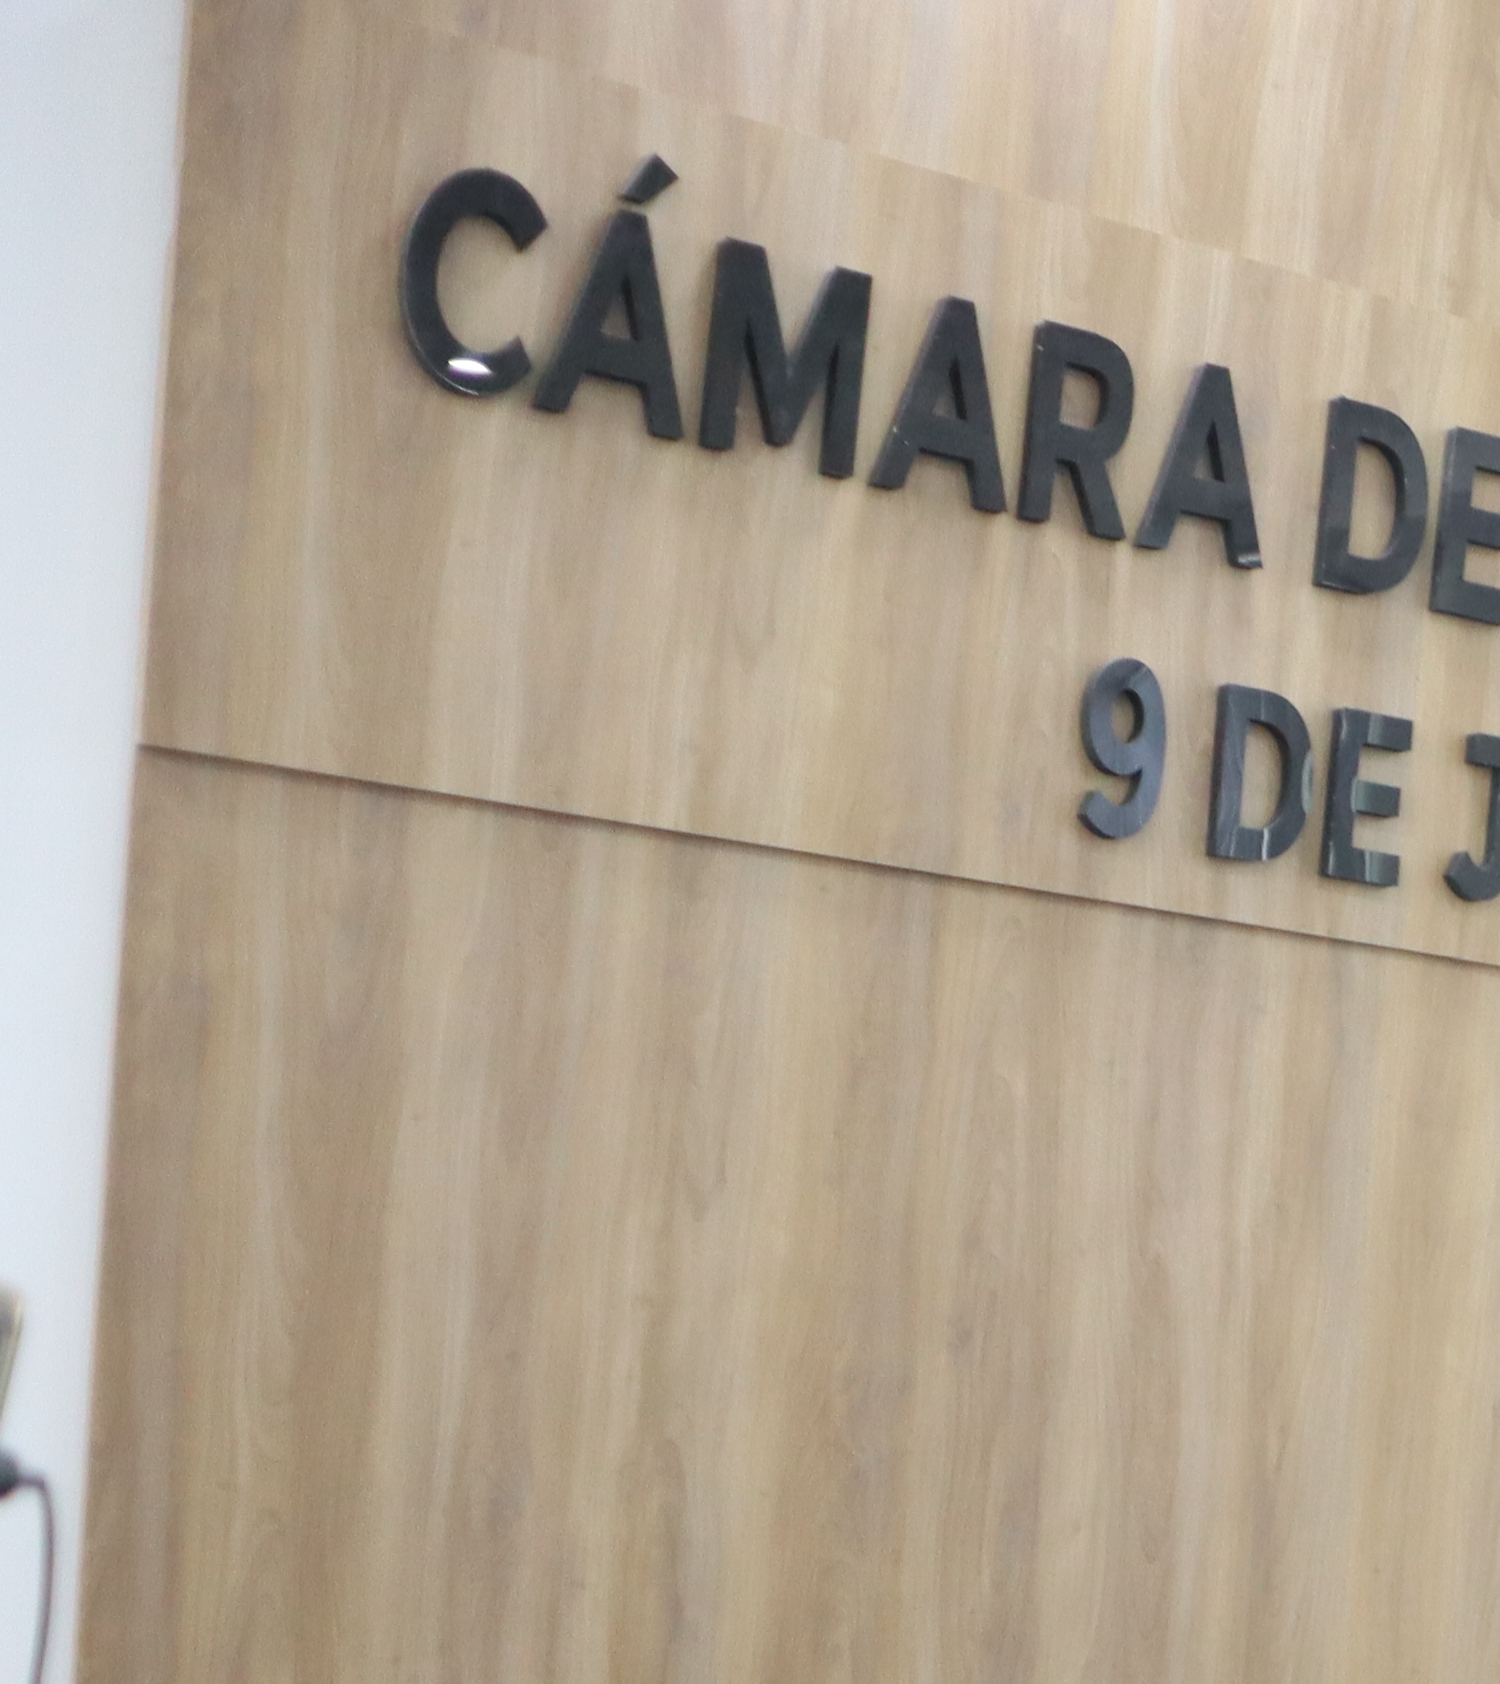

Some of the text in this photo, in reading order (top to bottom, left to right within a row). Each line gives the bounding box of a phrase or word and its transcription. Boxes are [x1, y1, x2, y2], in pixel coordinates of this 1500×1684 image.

[405, 153, 1263, 571] CÁMARA
[1078, 656, 1167, 840] 9
[1206, 682, 1414, 888] DE
